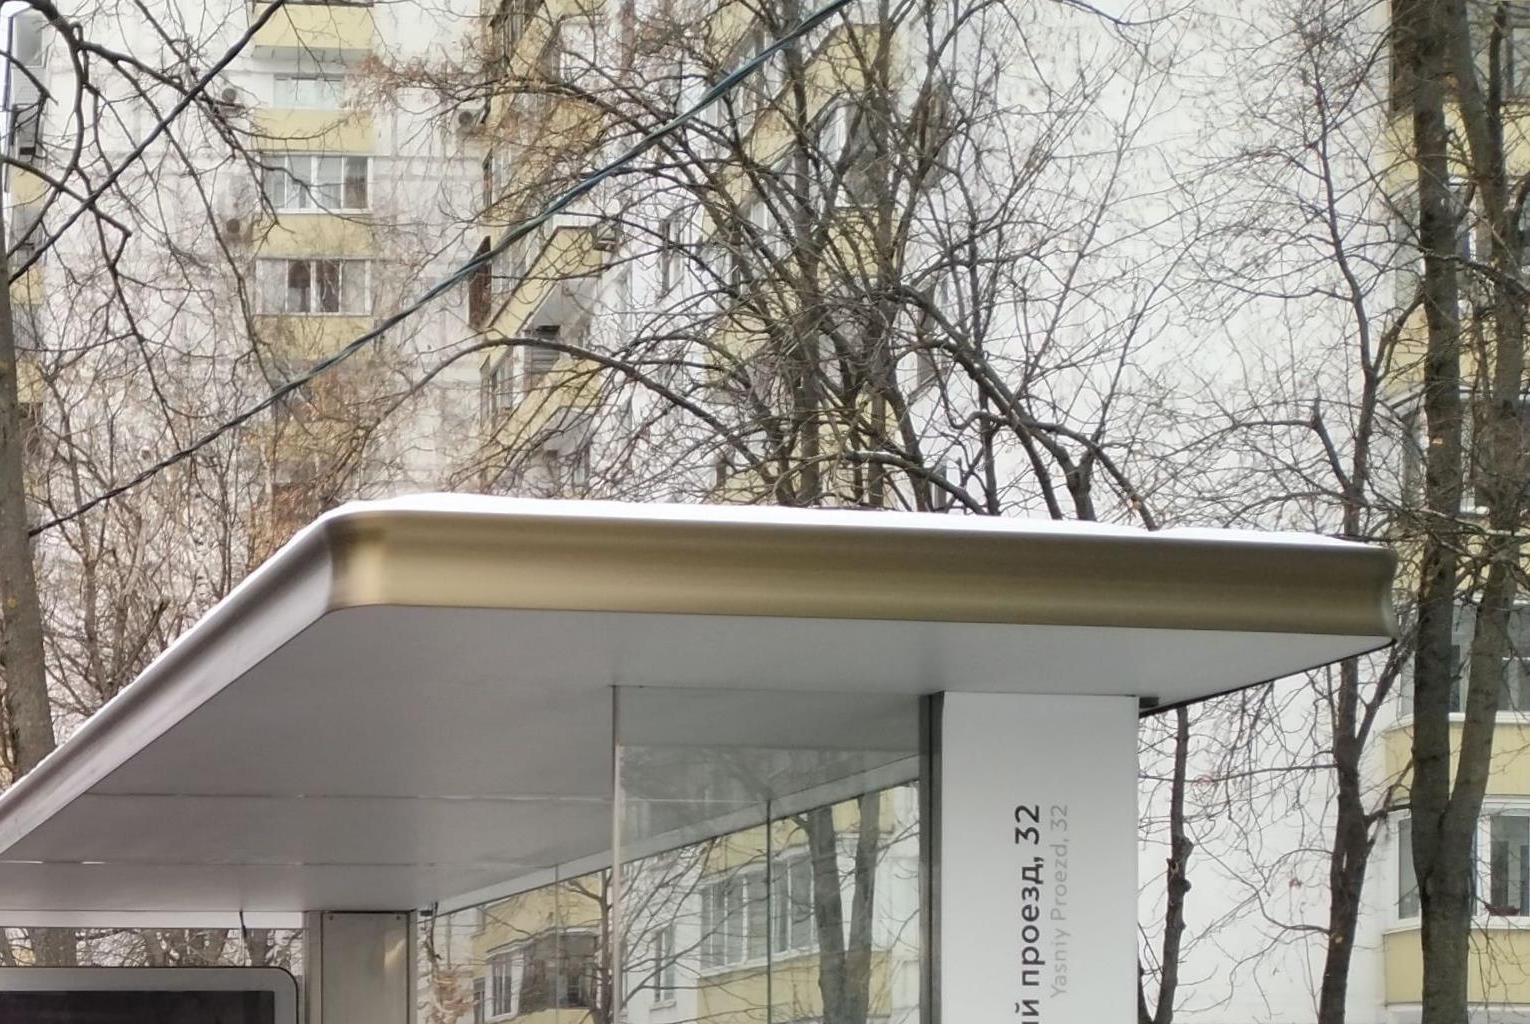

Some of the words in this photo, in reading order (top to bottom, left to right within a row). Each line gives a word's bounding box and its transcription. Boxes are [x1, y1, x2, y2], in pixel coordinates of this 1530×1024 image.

[1014, 804, 1041, 846] 32
[1049, 804, 1070, 831] 32
[1049, 836, 1070, 921] Proezd,
[1020, 855, 1046, 987] проезд,
[1049, 926, 1073, 999] Yasniy
